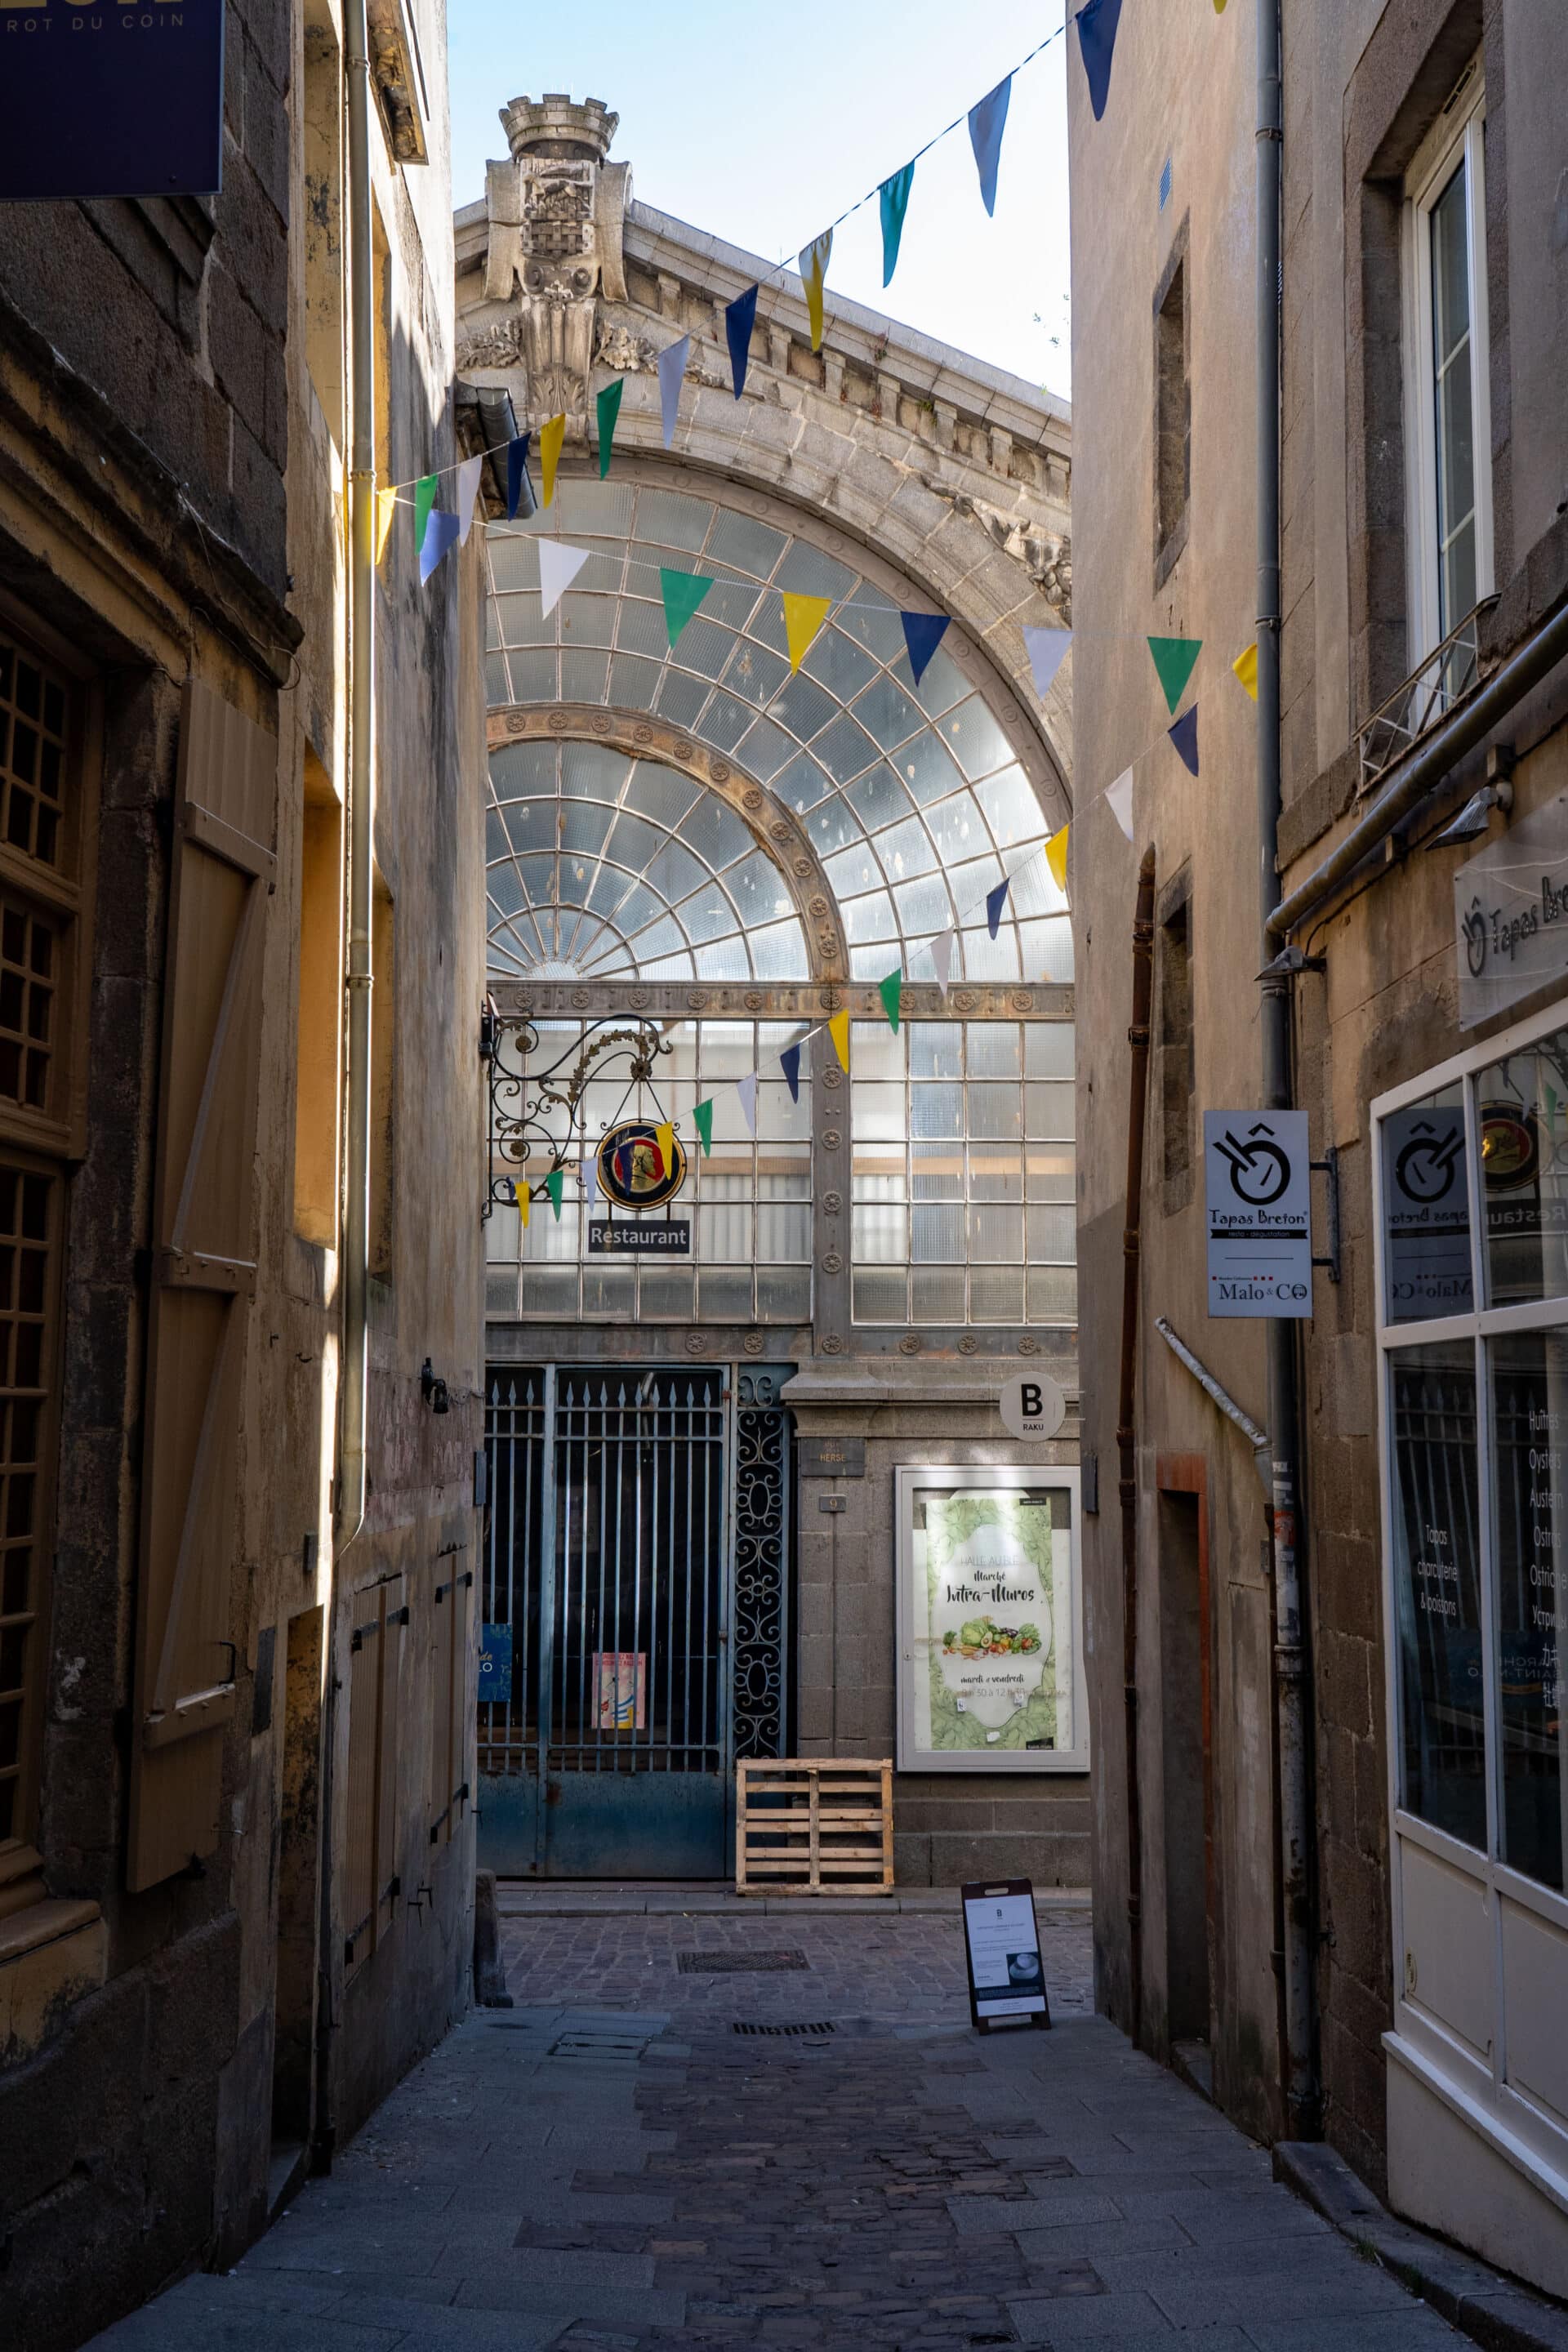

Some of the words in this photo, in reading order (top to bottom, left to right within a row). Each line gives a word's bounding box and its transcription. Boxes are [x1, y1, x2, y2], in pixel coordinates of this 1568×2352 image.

[72, 16, 103, 31] DU
[122, 14, 185, 29] COIN
[1490, 903, 1539, 961] Tapas
[1209, 1209, 1254, 1228] Tapas
[590, 1227, 687, 1245] Restaurant
[1218, 1283, 1264, 1300] Malo
[1021, 1383, 1043, 1416] B
[1529, 1409, 1559, 1431] Huîtres
[819, 1453, 847, 1463] HERSE
[1529, 1448, 1561, 1474] Oysters
[1425, 1524, 1448, 1545] Tapas
[973, 1570, 1006, 1582] Marché
[1417, 1560, 1458, 1582] charcuterie
[947, 1584, 1035, 1603] Intra-Muros
[1420, 1591, 1427, 1610] &
[1428, 1593, 1456, 1616] poissons
[960, 1675, 983, 1684] mardi
[991, 1673, 1025, 1684] vendredi
